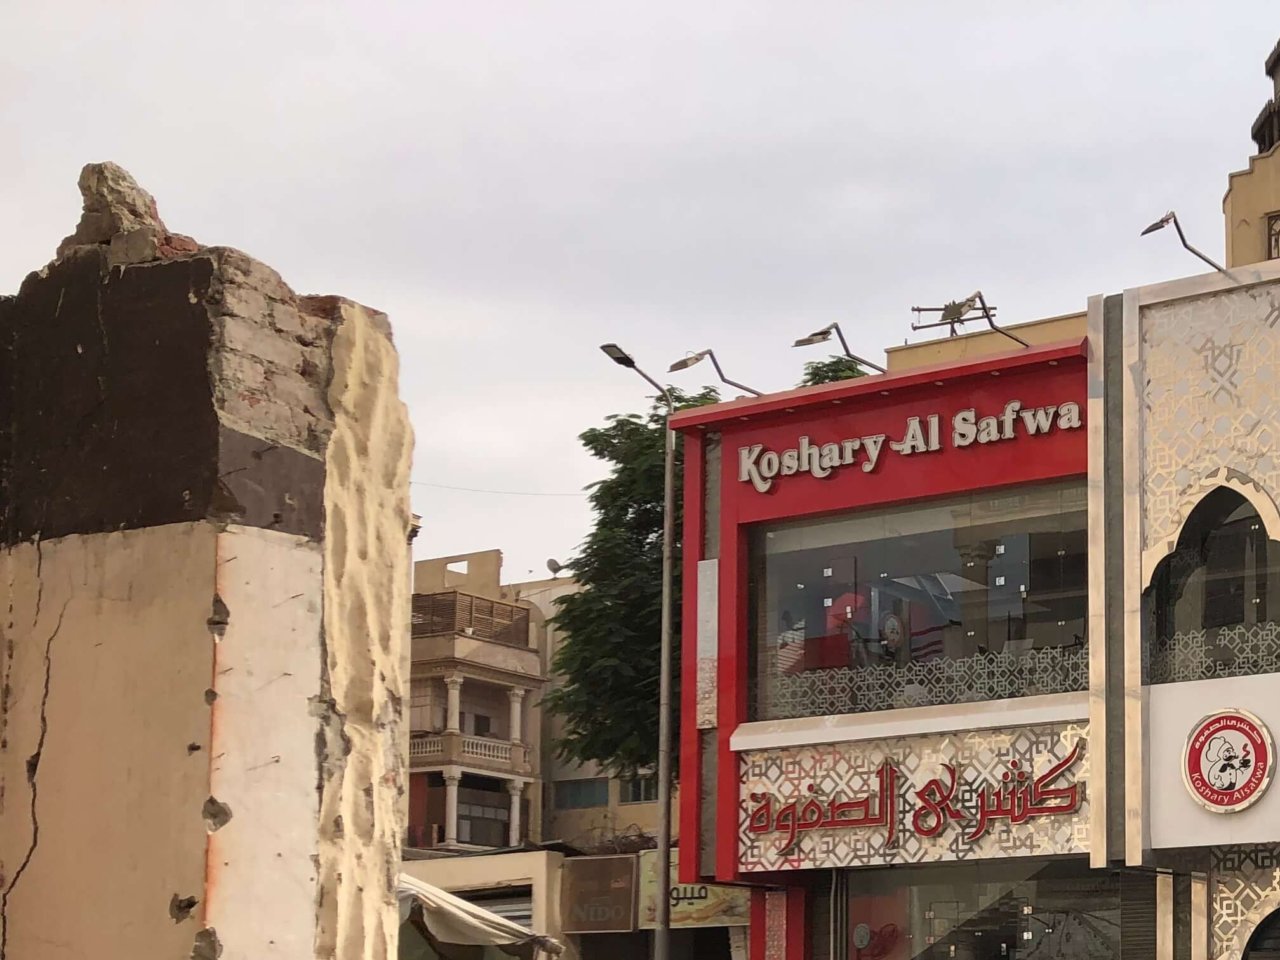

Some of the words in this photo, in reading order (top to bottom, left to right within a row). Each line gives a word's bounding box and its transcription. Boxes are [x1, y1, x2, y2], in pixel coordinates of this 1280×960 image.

[737, 434, 886, 493] Koshary
[889, 414, 942, 455] Al
[952, 400, 1082, 447] Safwa
[749, 757, 898, 855] الصفوة
[1191, 772, 1230, 804] Koshary
